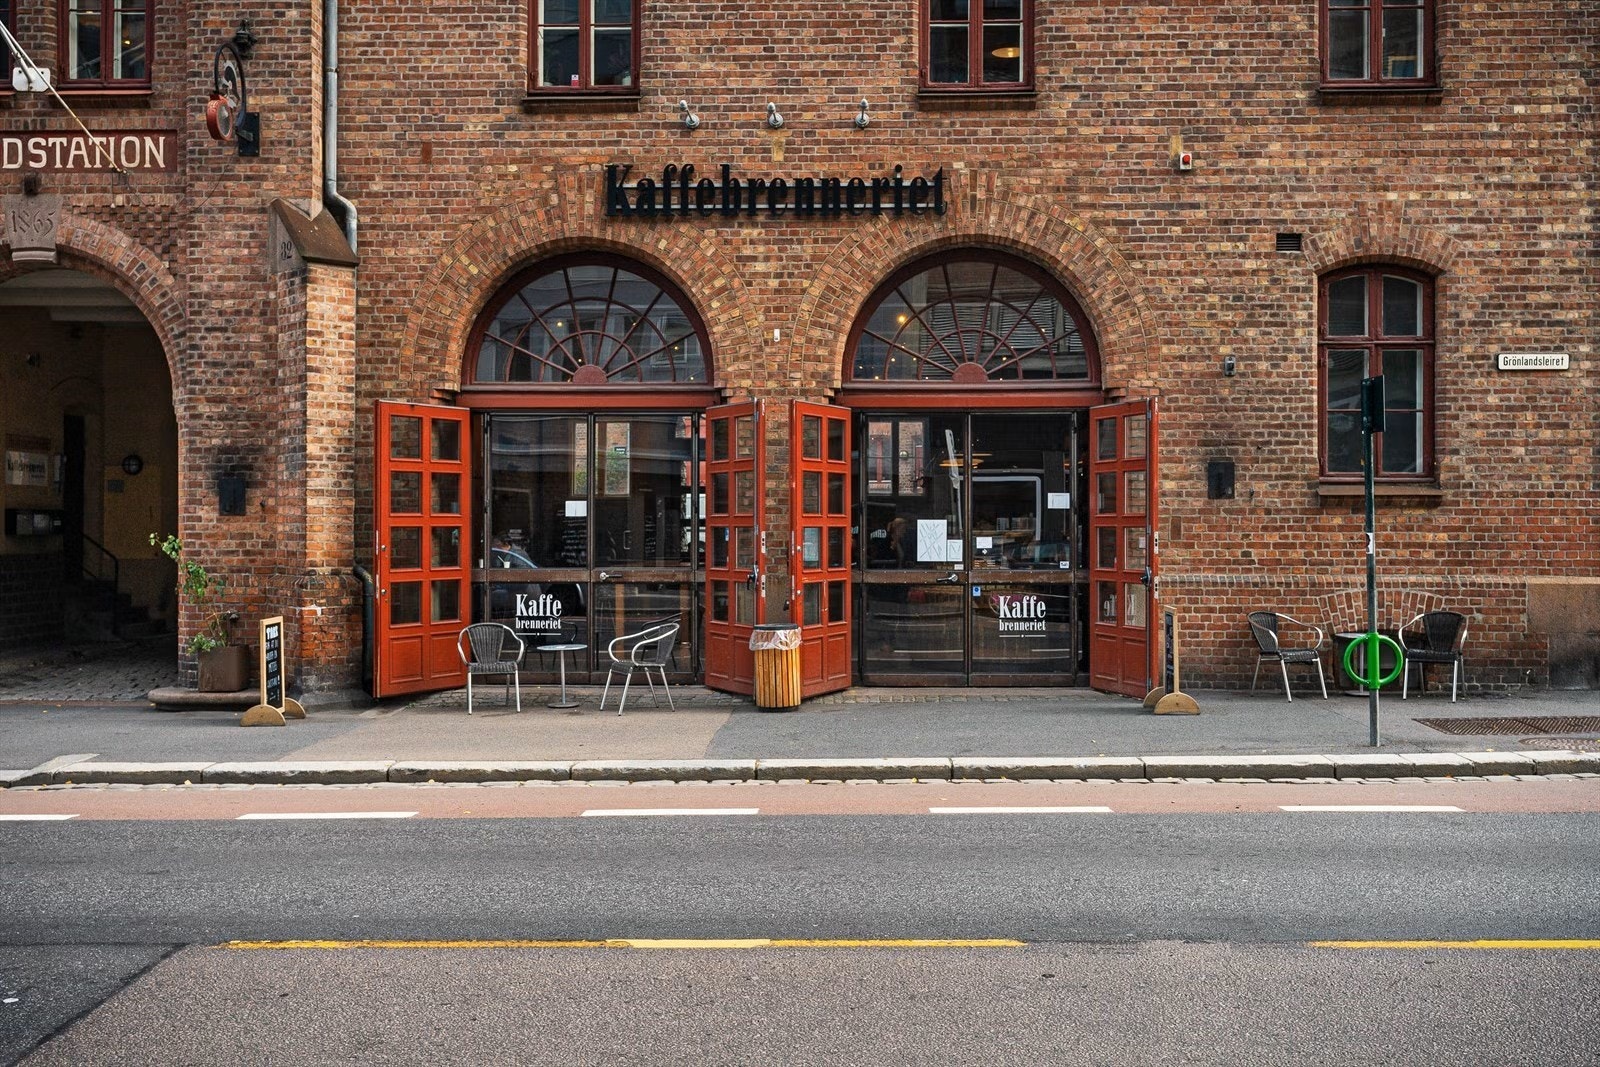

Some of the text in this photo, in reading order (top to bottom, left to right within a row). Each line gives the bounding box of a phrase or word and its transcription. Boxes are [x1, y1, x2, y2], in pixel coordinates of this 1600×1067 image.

[605, 164, 948, 216] Kaffebrenneriet
[12, 210, 56, 237] 1865
[1503, 356, 1564, 366] Grönlandsleiret
[515, 593, 562, 617] Kaffe
[998, 595, 1046, 619] Kaffe
[515, 617, 562, 629] brenneriet
[998, 619, 1046, 631] brenneriet
